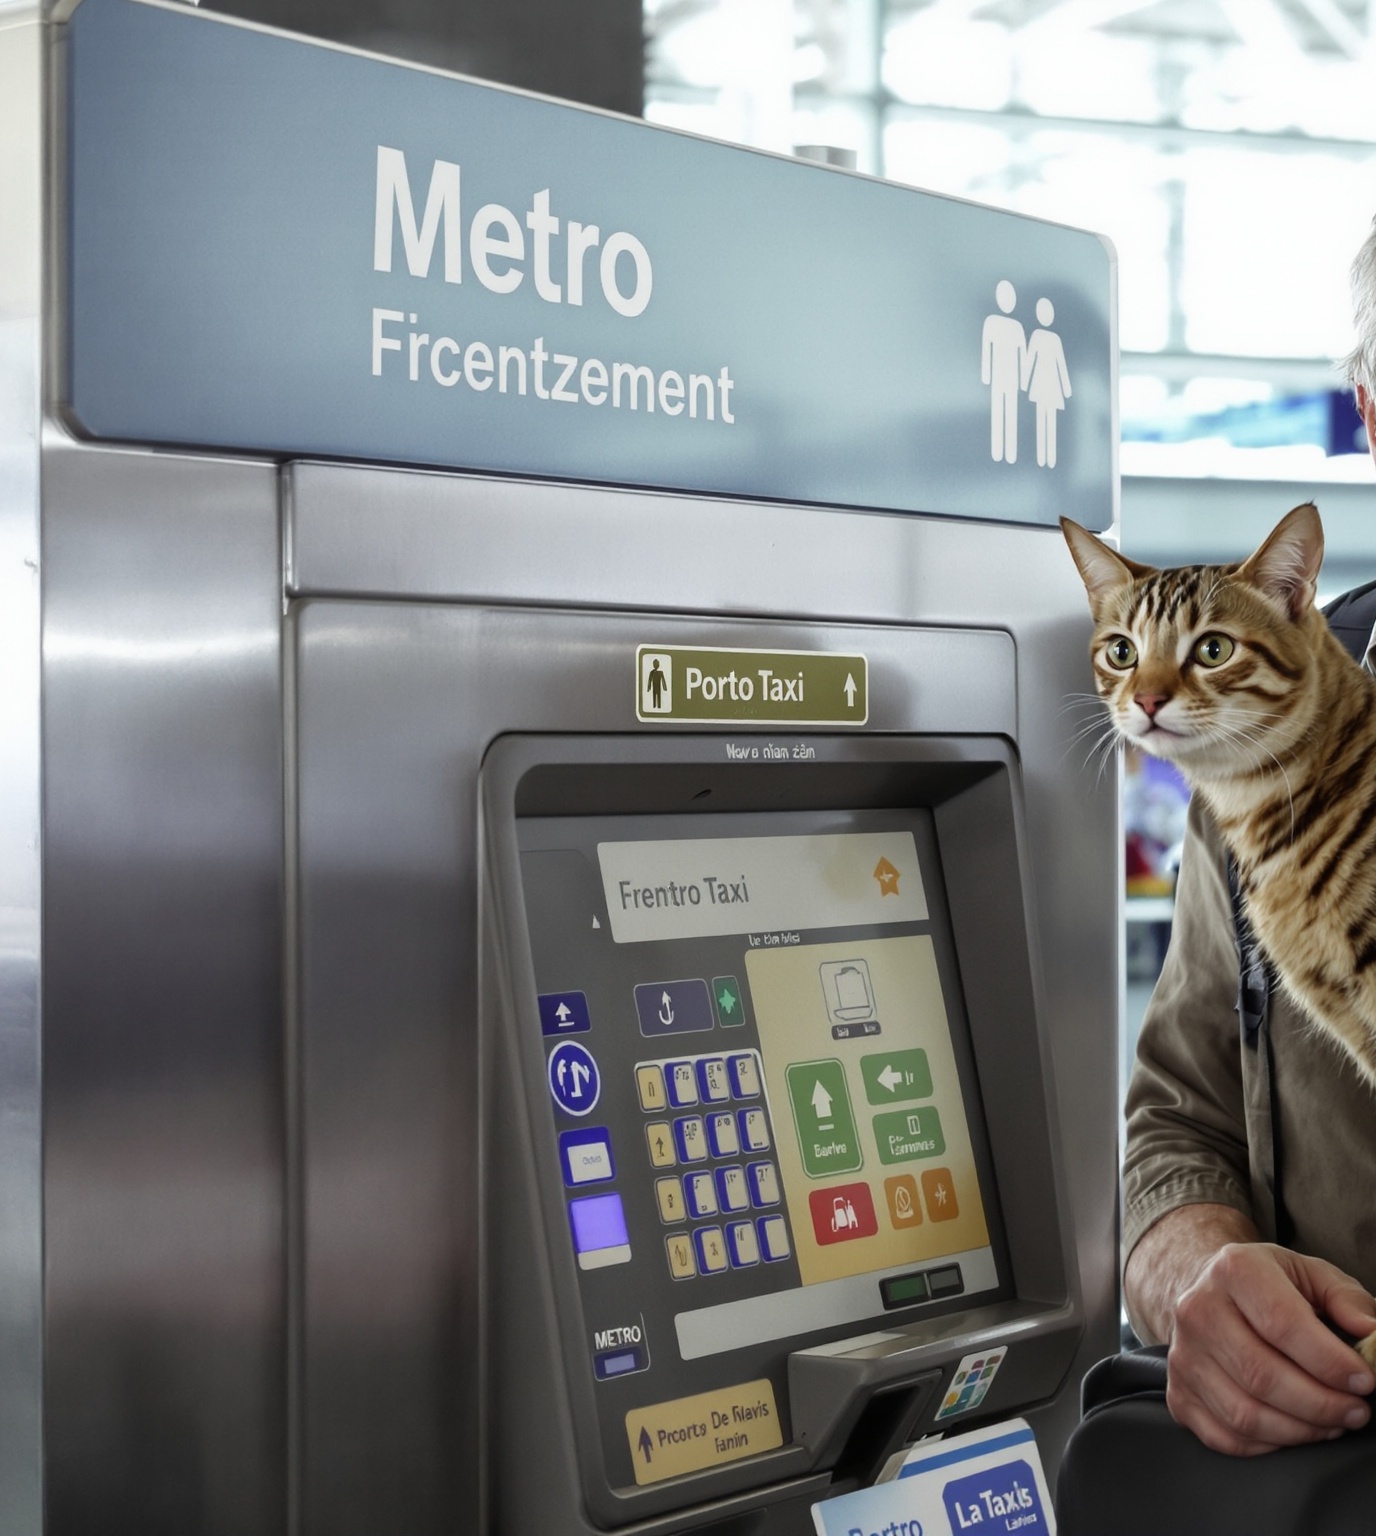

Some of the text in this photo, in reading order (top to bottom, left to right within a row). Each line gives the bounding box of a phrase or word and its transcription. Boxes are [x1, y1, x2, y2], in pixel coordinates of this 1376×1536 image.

[372, 144, 654, 319] Metro
[685, 667, 804, 703] Porto Taxi
[618, 874, 750, 910] Frentro Taxi
[594, 1325, 642, 1350] METRO
[710, 1410, 730, 1430] De
[954, 1501, 984, 1529] La
[978, 1480, 1034, 1519] Taxis
